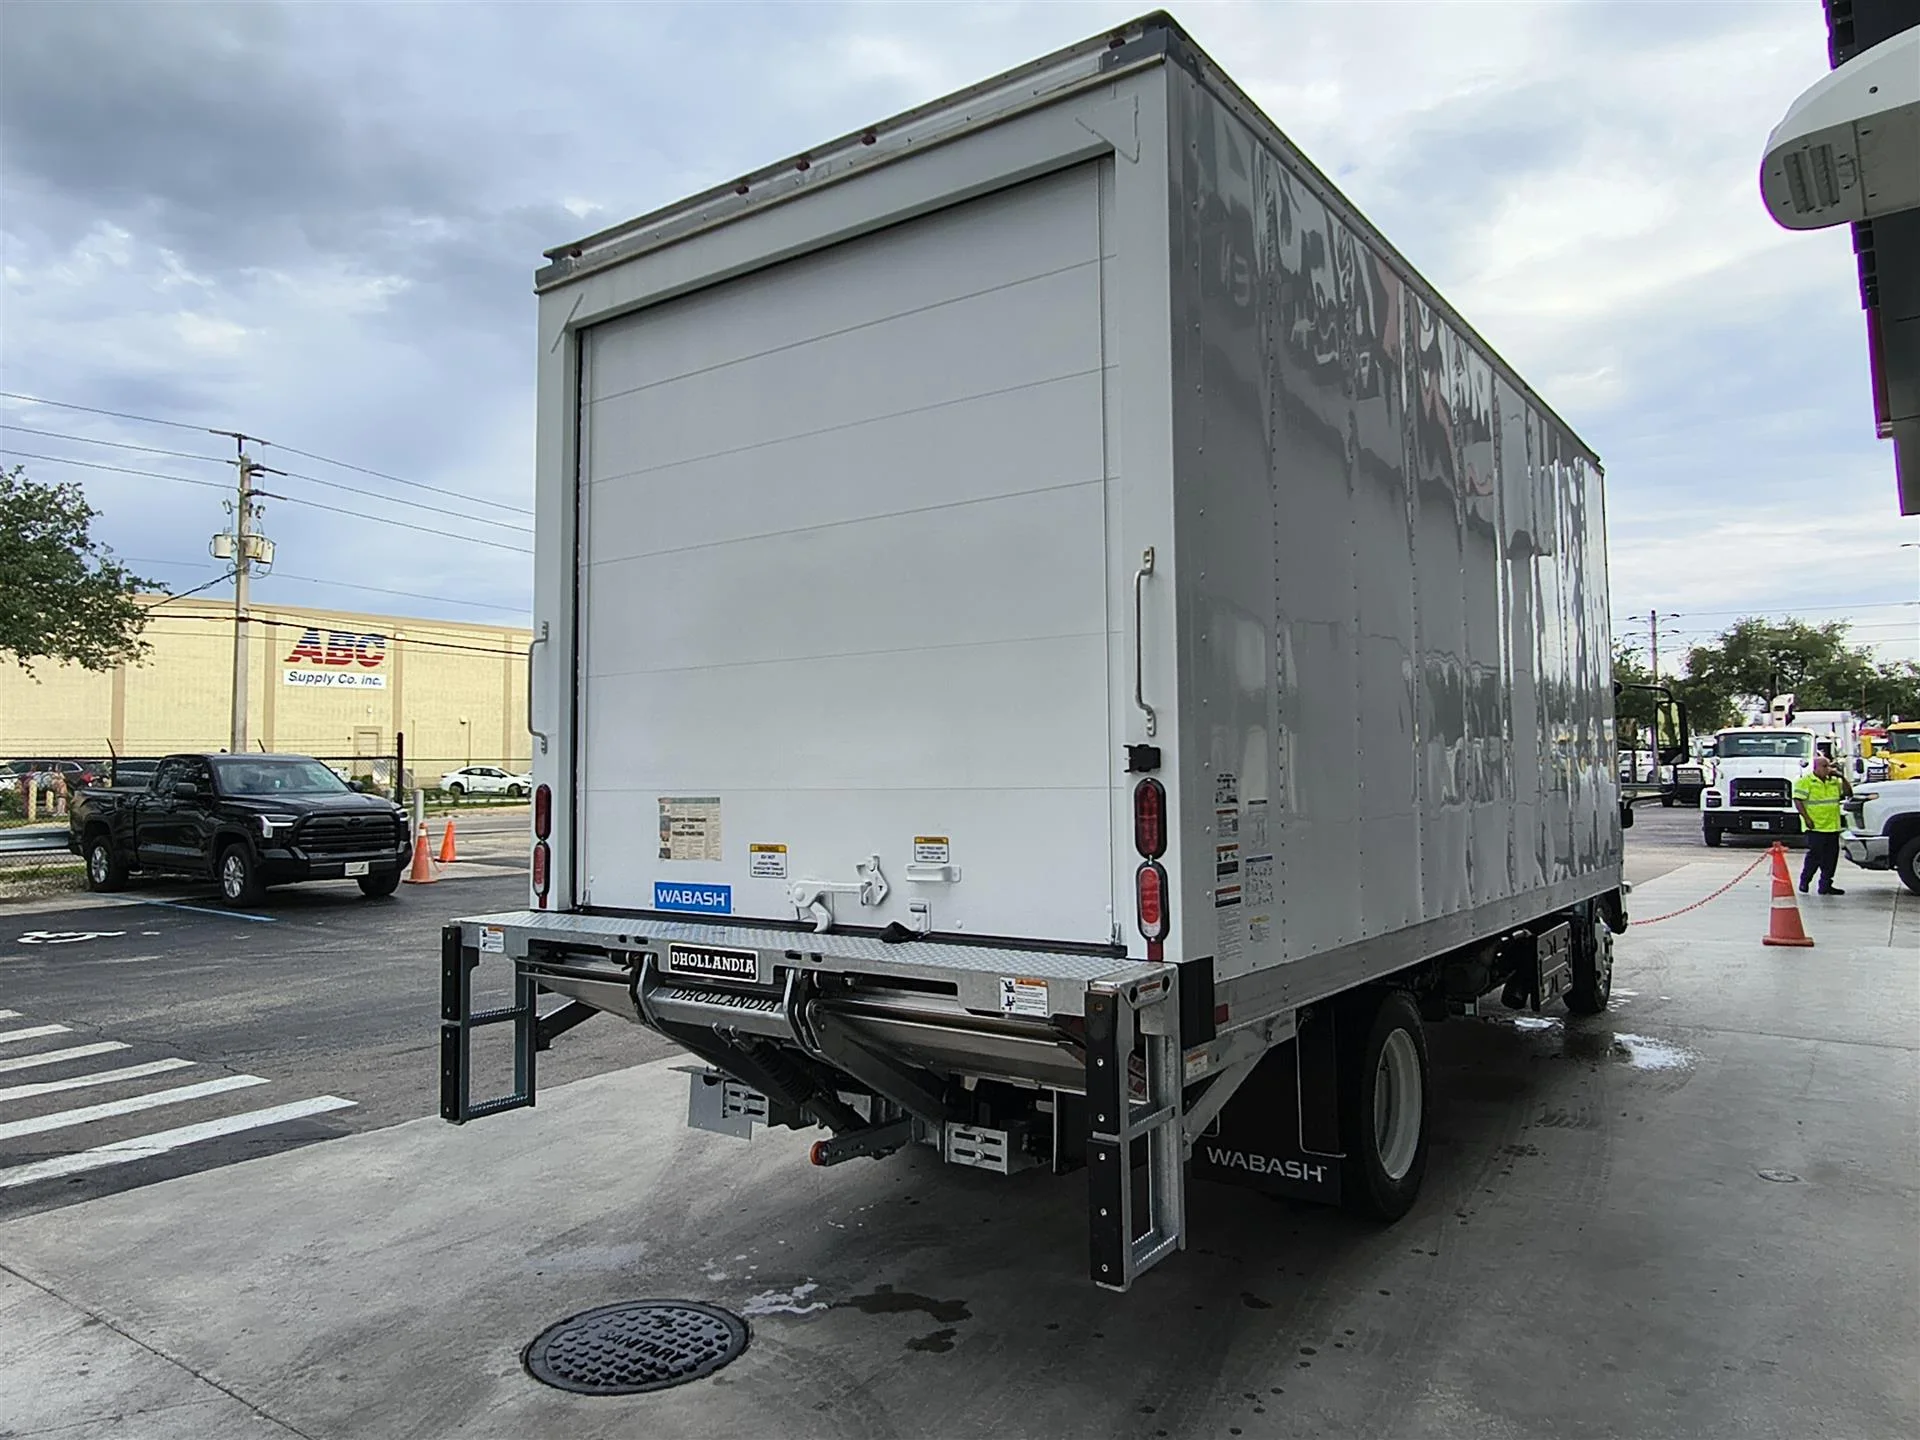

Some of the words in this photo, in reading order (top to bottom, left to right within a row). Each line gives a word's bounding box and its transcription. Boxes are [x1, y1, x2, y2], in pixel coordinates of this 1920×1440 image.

[284, 628, 386, 668] ABC
[288, 671, 335, 686] Supply
[338, 673, 358, 685] Co.
[657, 888, 726, 907] WABASH
[671, 951, 755, 974] DHOLLANDIA
[671, 988, 779, 1012] DHOLLANDIA
[1206, 1146, 1324, 1183] WABASH
[600, 1331, 689, 1364] SANITARY
